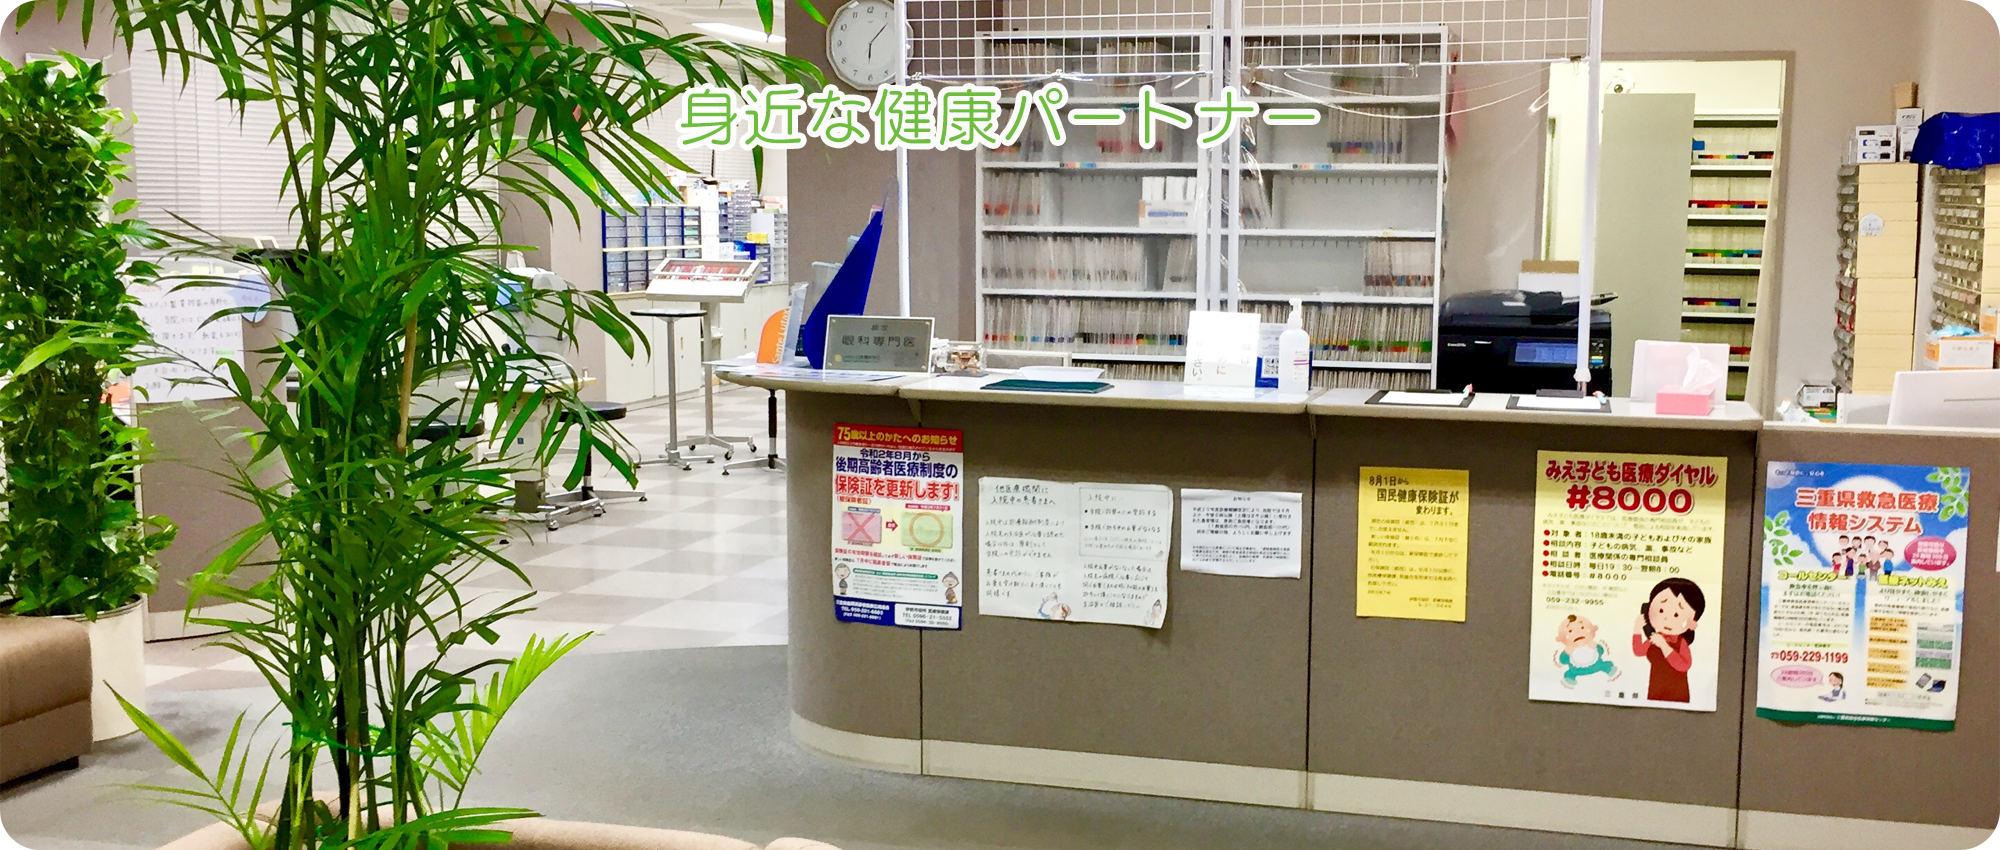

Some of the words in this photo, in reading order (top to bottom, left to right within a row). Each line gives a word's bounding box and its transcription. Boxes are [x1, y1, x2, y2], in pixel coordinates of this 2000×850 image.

[837, 426, 958, 446] 75歳以上のかたへのお知らせ
[860, 448, 931, 462] 令和2年8月から
[836, 456, 958, 479] 後期高齢者医療制度の
[1545, 460, 1716, 486] みえ子ども医療ダイヤル
[1368, 474, 1410, 487] 8月1日から
[1376, 488, 1460, 504] 国民健康保険証が
[1566, 484, 1692, 513] #8000
[1797, 488, 1938, 512] 三重県救急医療
[1416, 505, 1453, 516] 変わります。
[1808, 513, 1922, 534] 情報システム
[1777, 570, 1848, 582] コールセンター
[1780, 650, 1848, 664] 059-229-1199
